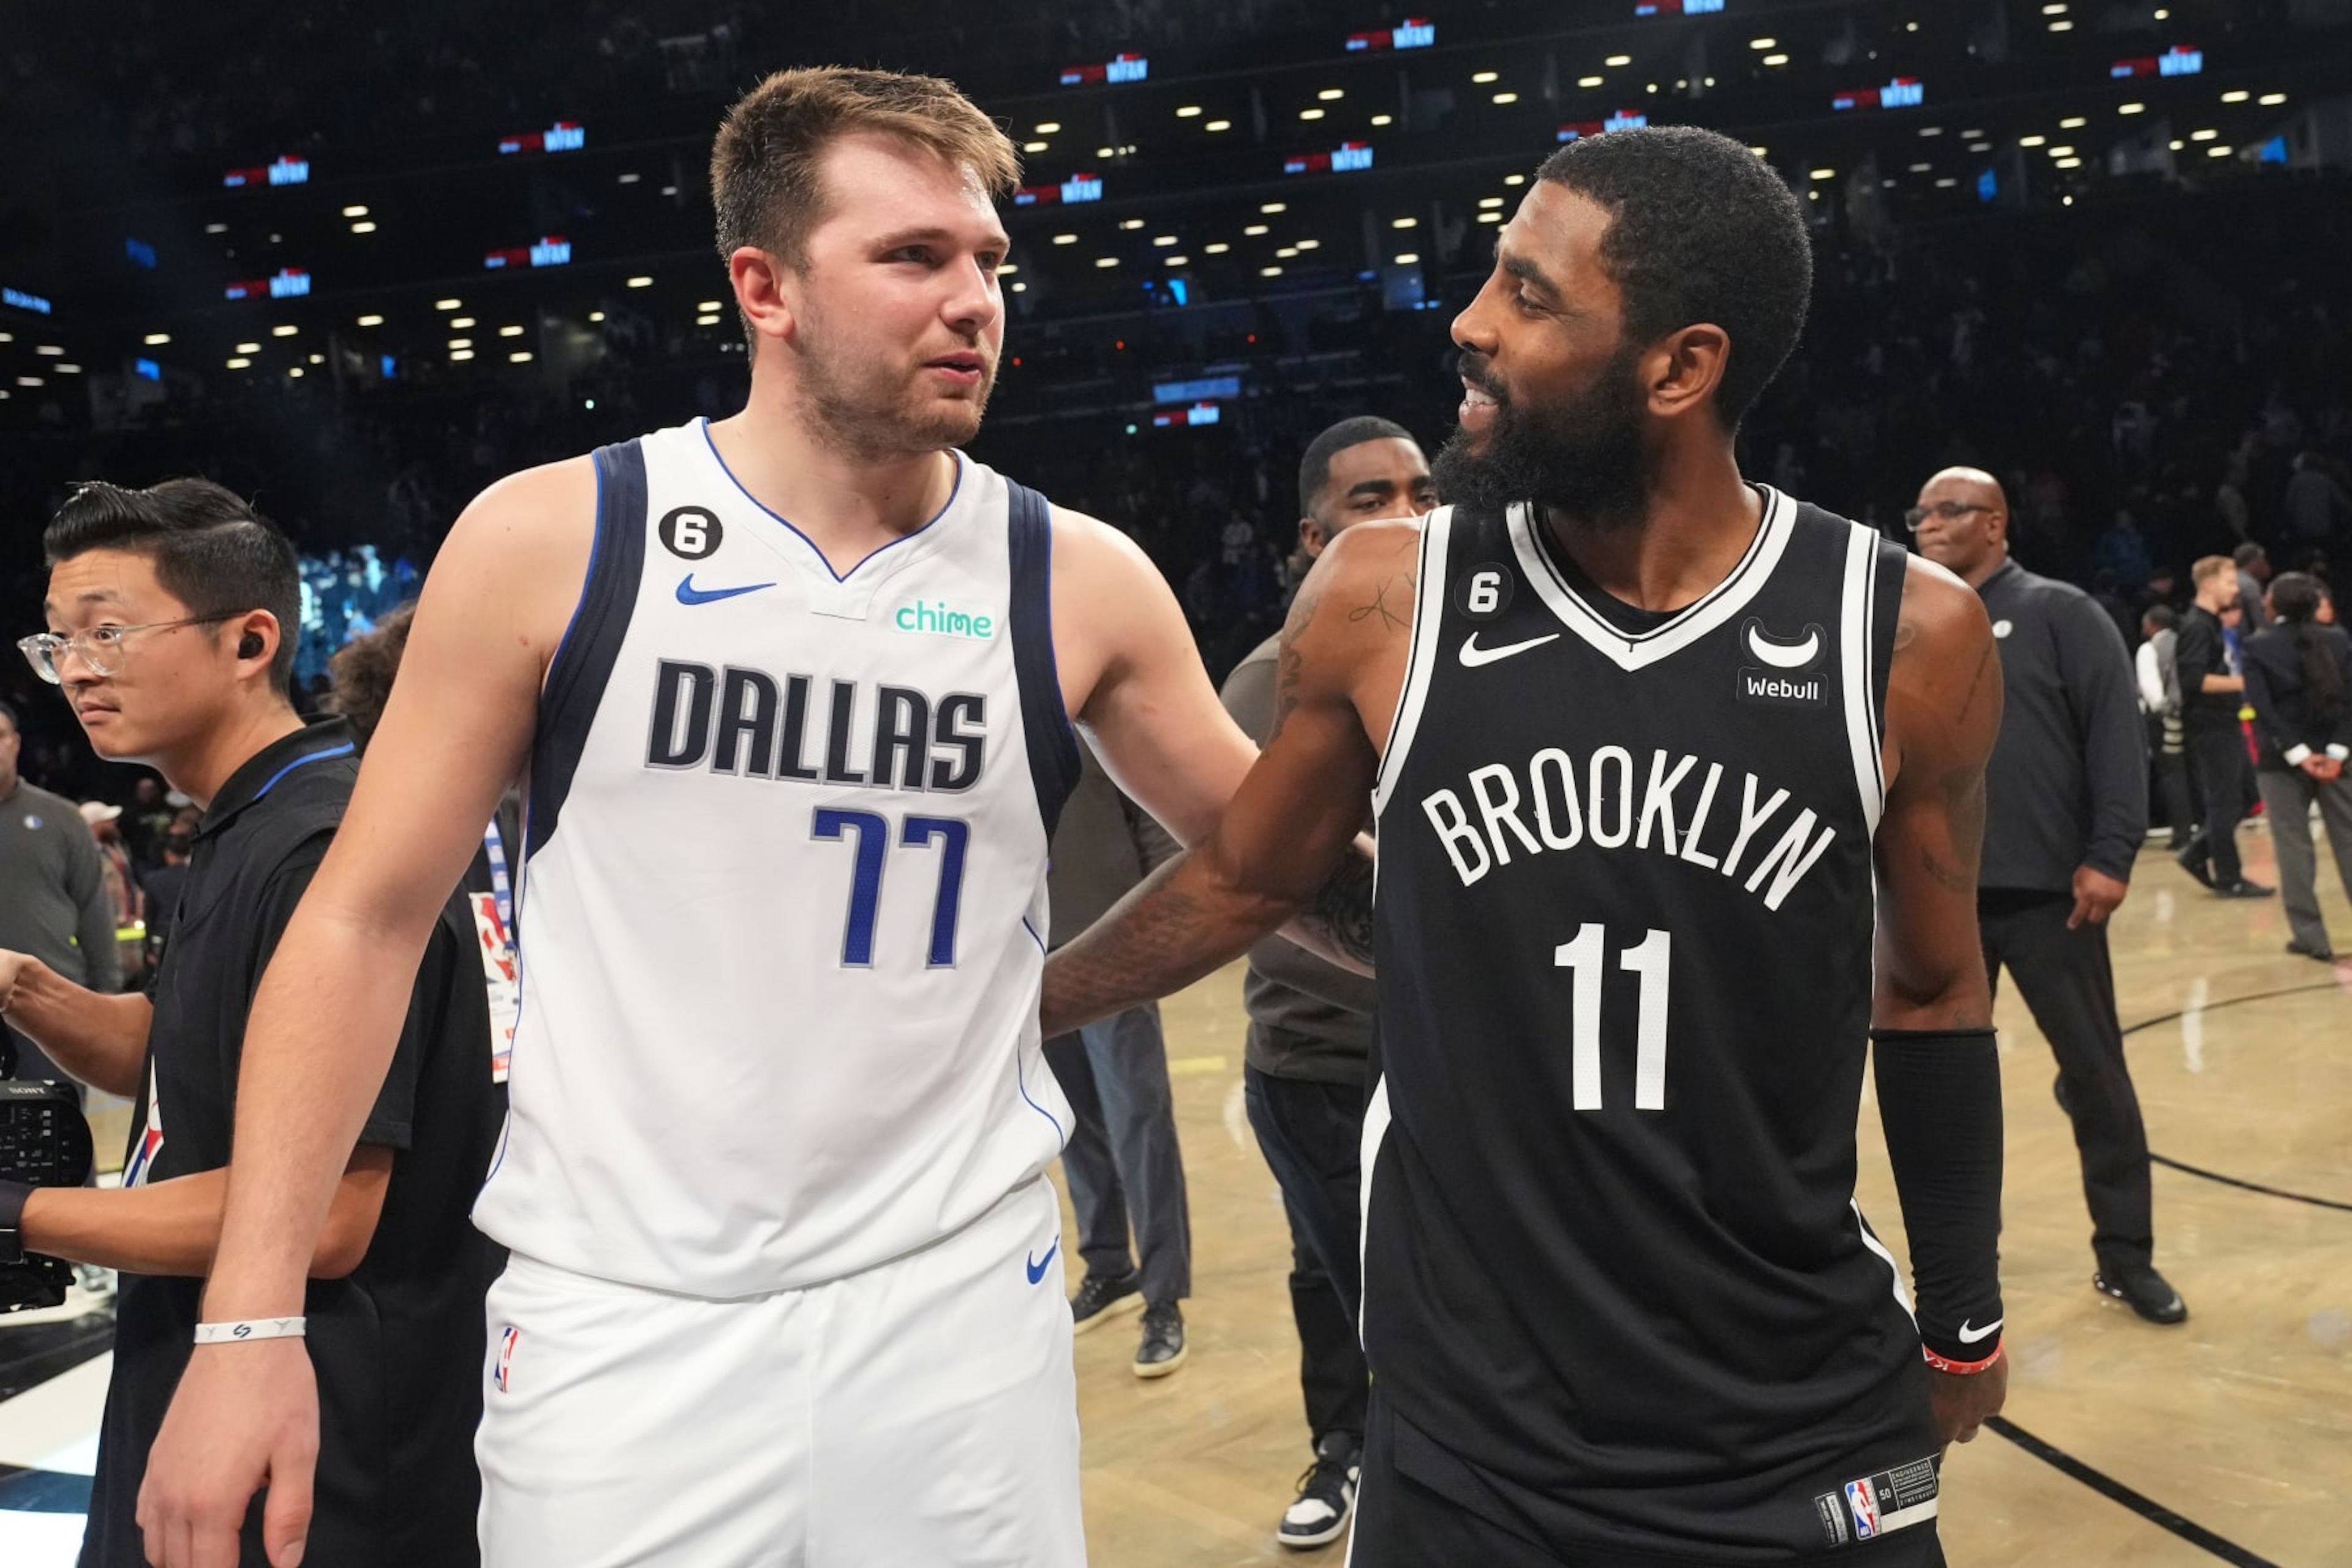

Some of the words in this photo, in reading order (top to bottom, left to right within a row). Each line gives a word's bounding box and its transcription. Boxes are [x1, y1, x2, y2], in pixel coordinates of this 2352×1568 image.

[674, 513, 708, 554] 6
[1468, 571, 1501, 612] 6
[895, 600, 992, 638] chime
[1747, 677, 1819, 700] Webull
[644, 657, 987, 794] DALLAS
[1421, 745, 1837, 912] BROOKLYN
[810, 805, 971, 969] 77
[1554, 922, 1671, 1110] 11
[1878, 1487, 1892, 1500] 50
